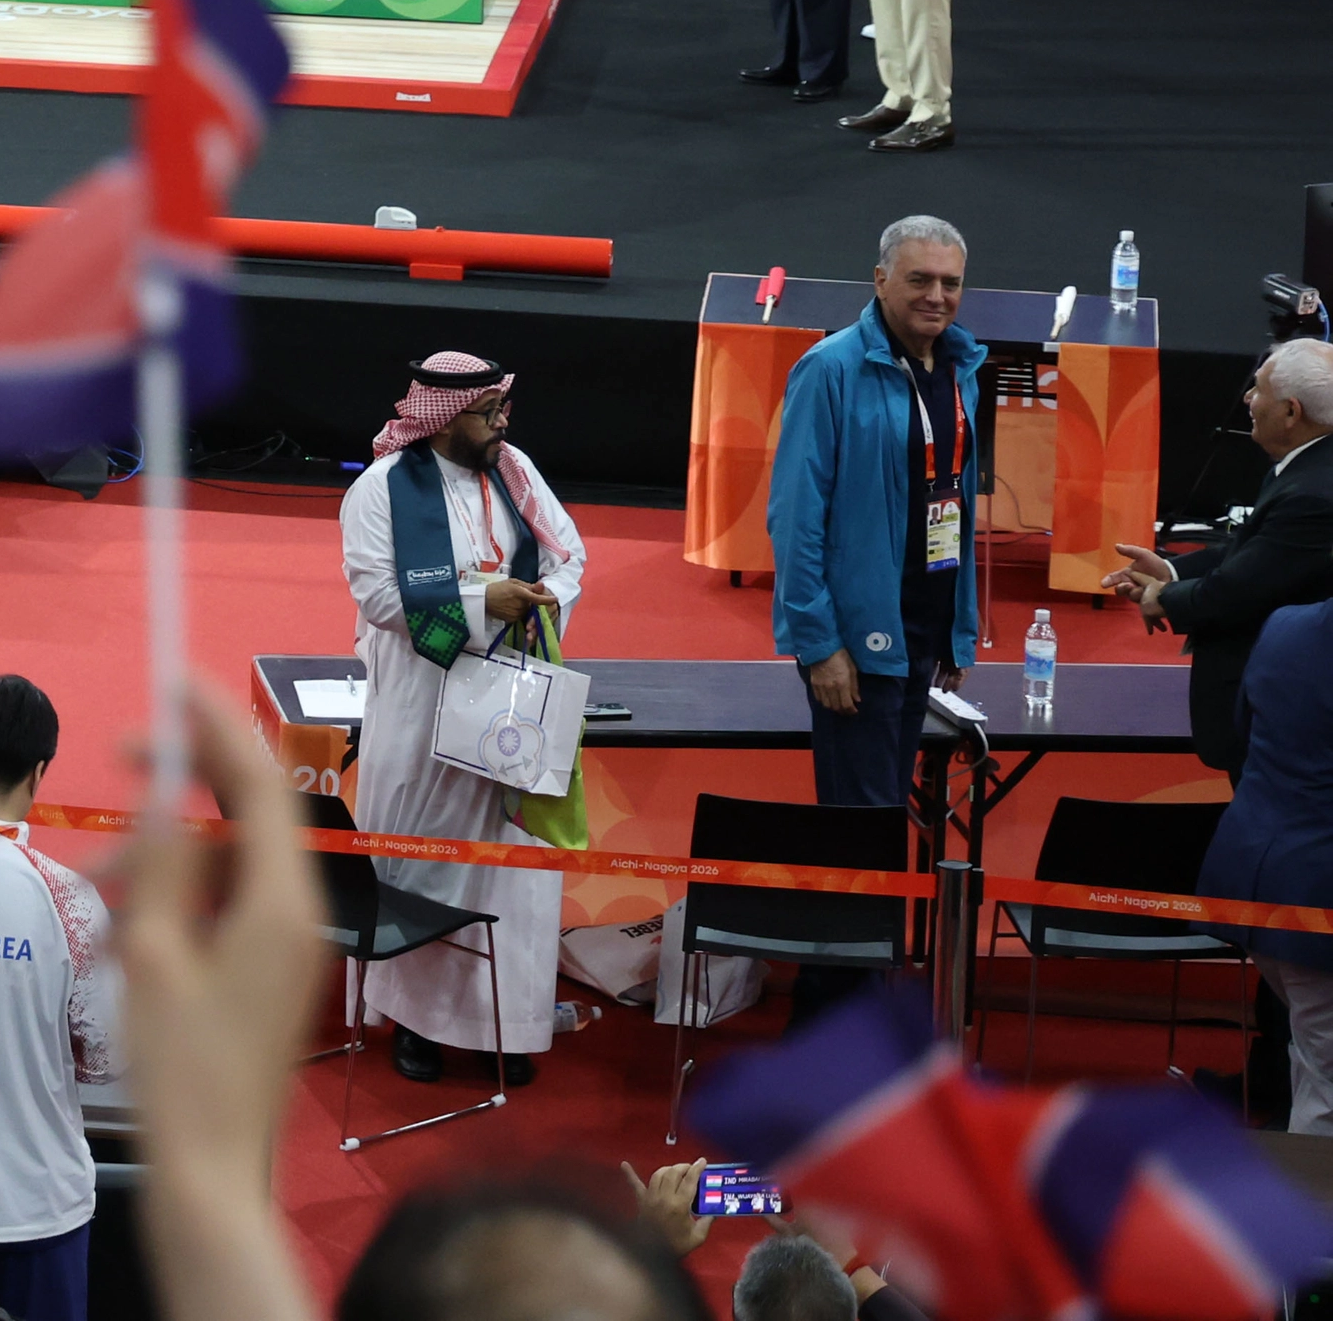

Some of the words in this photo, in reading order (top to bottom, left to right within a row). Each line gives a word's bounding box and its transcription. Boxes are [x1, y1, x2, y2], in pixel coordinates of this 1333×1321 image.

[351, 836, 428, 855] Aichi-Nagoya
[430, 843, 459, 856] 2026
[610, 858, 688, 875] Aichi-Nagoya
[690, 864, 720, 876] 2026
[1088, 891, 1170, 911] Aichi-Nagoya
[1172, 899, 1203, 913] 2026
